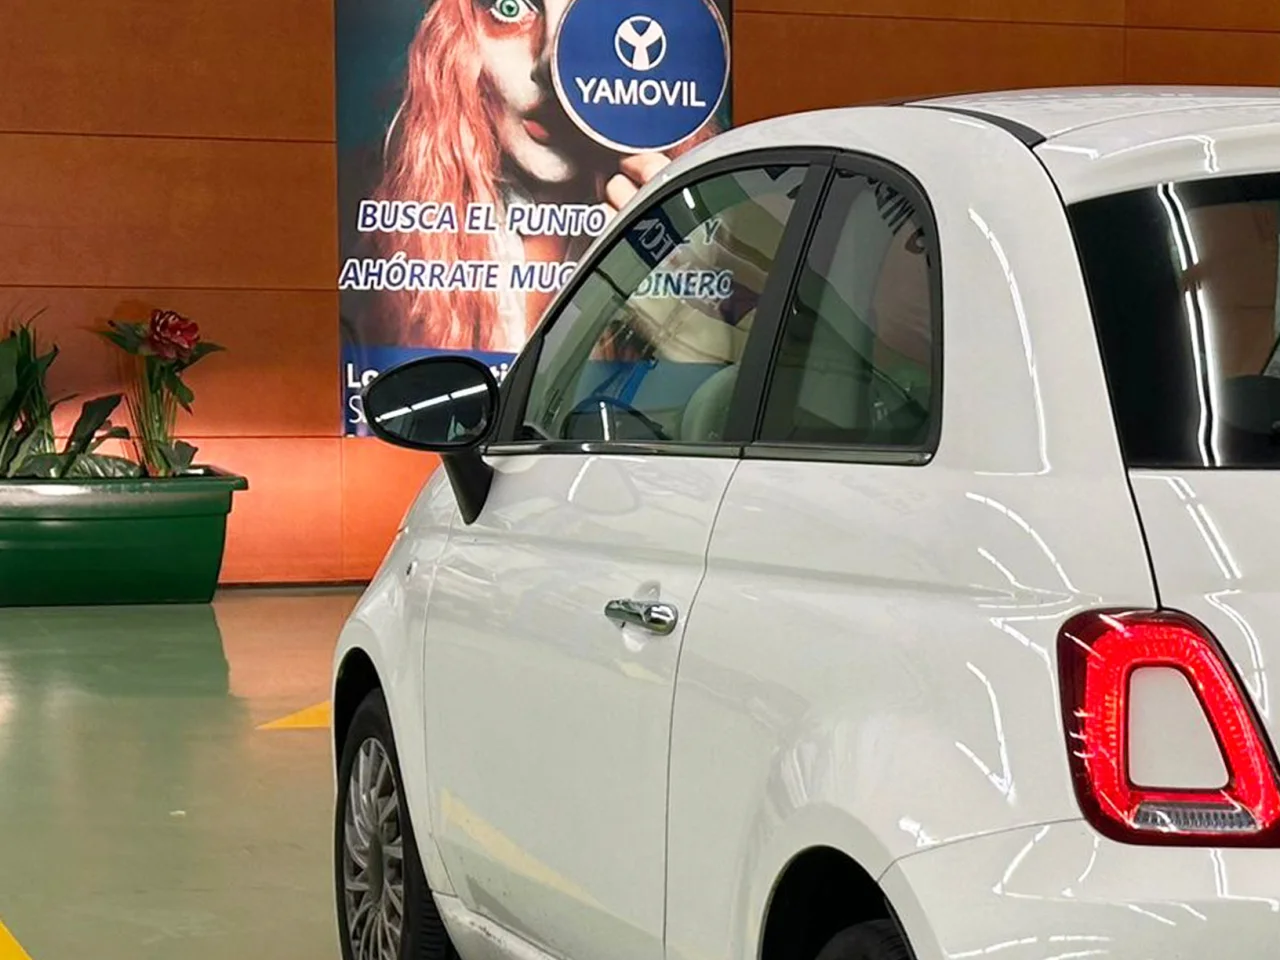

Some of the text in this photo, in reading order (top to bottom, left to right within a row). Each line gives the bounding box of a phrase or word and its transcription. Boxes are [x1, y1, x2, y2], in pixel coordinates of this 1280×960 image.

[575, 76, 706, 107] YAMOVIL
[358, 199, 458, 233] BUSCA
[464, 202, 497, 234] EL
[506, 202, 608, 236] PUNTO
[339, 251, 500, 291] AHÓRRATE
